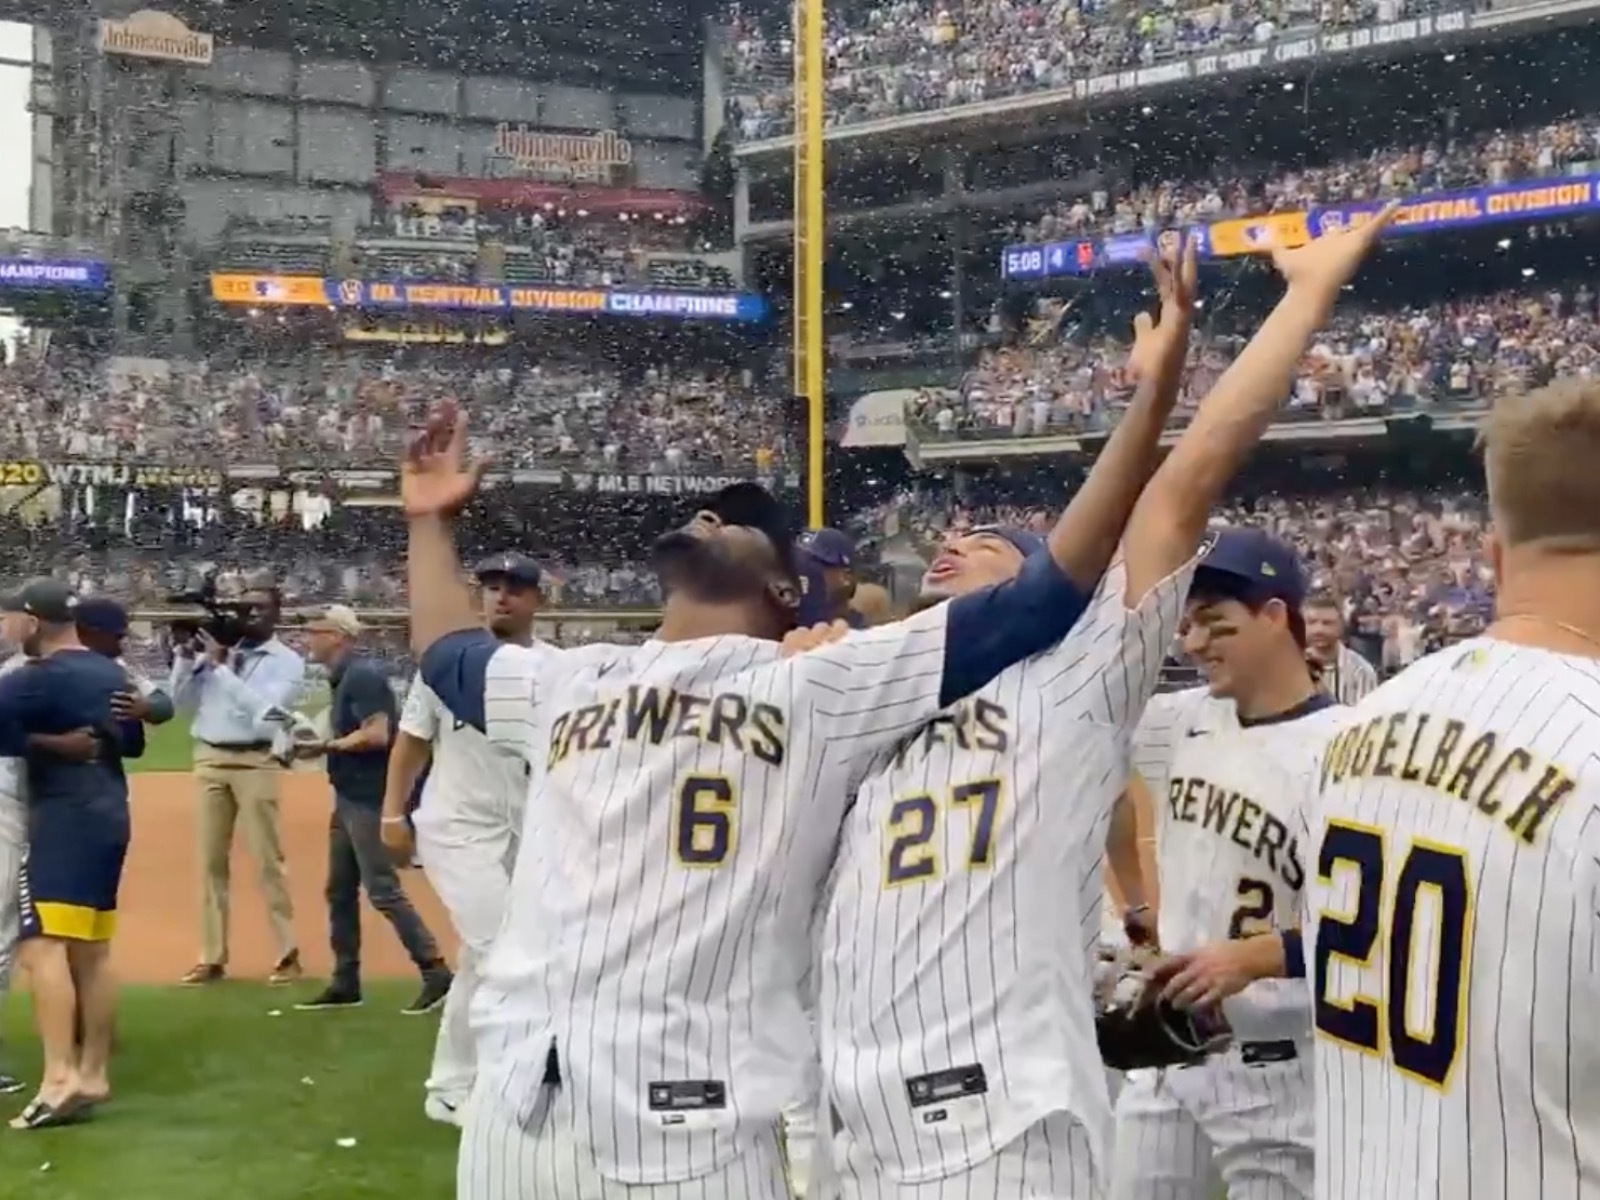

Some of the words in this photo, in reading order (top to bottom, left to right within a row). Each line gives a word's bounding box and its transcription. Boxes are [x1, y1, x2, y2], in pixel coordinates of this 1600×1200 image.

[1487, 182, 1591, 214] DIVISION
[1008, 251, 1041, 272] 5:08
[405, 286, 505, 306] CENTRAL
[509, 289, 604, 309] DIVISION
[611, 292, 738, 314] CHAMPIONS
[51, 464, 129, 485] WTMJ
[675, 774, 736, 867] 6
[884, 778, 1003, 888] 27
[1315, 818, 1470, 1094] 20
